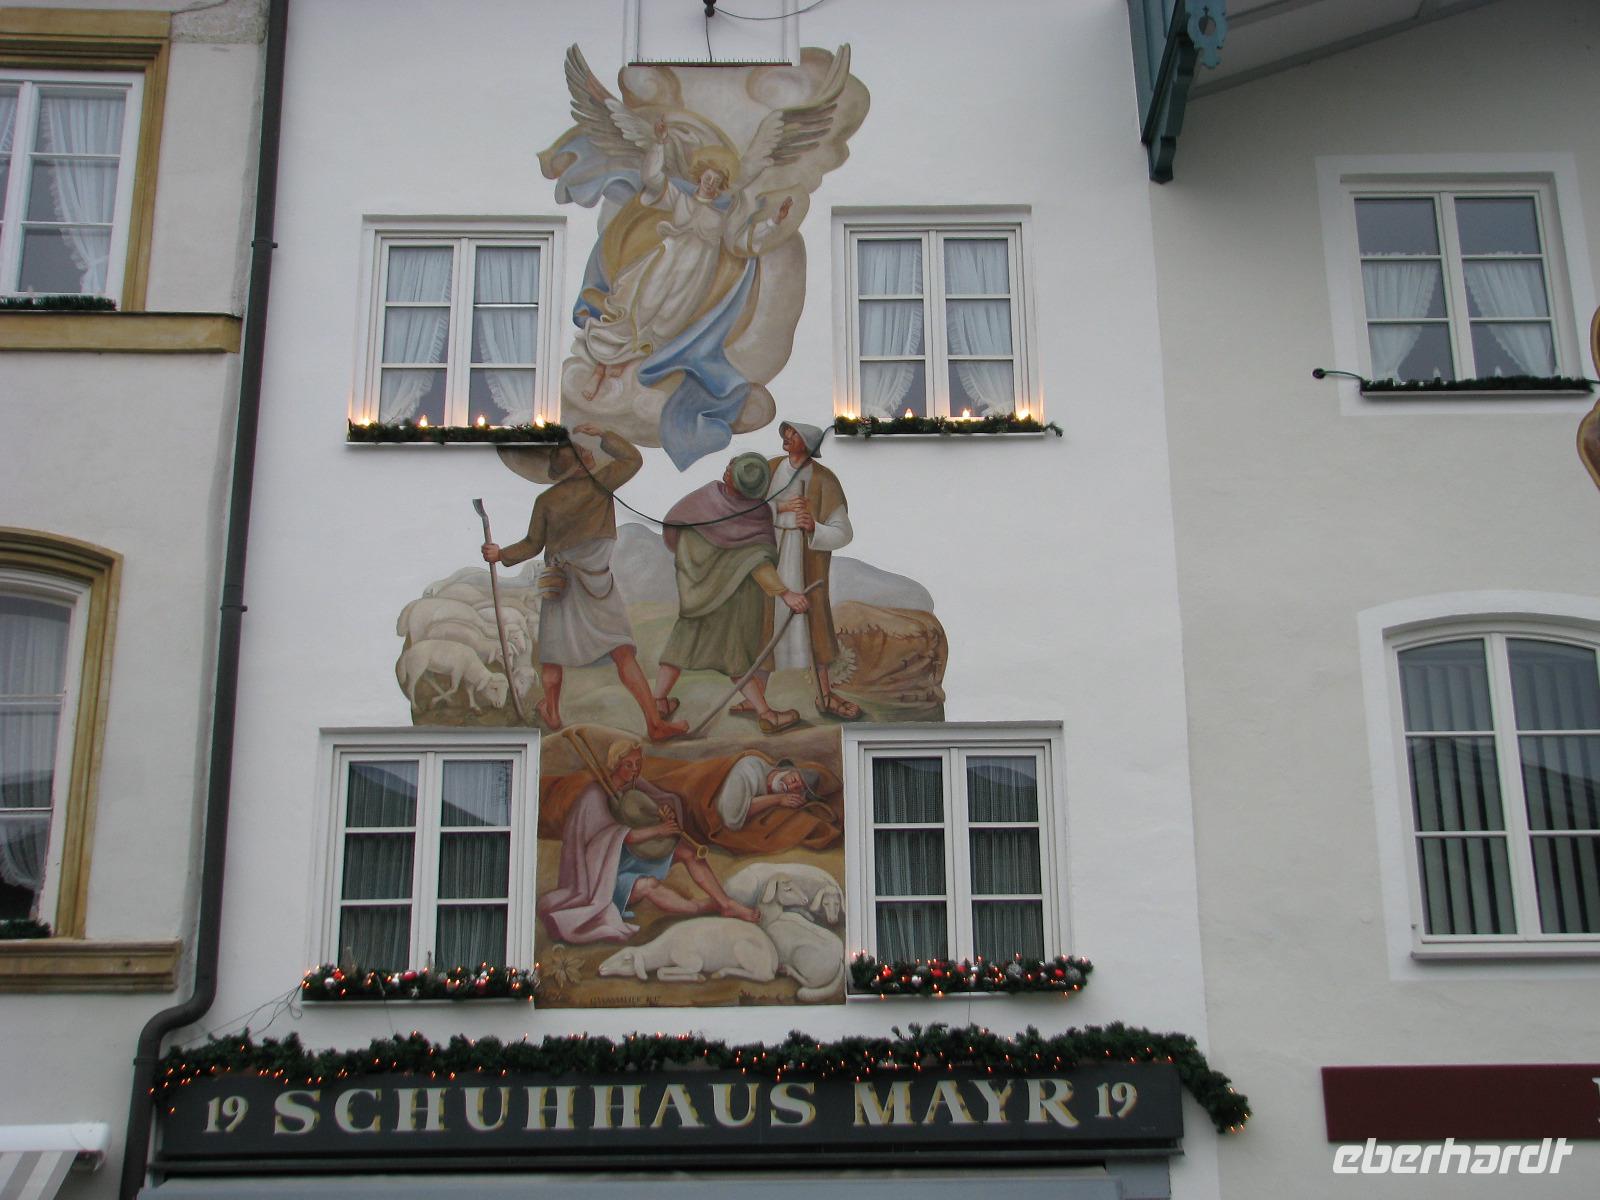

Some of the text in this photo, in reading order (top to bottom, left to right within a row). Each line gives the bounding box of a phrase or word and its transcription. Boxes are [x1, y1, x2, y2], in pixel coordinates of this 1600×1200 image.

[204, 1079, 1138, 1134] 19 SCHUHHAUS MAYR 19
